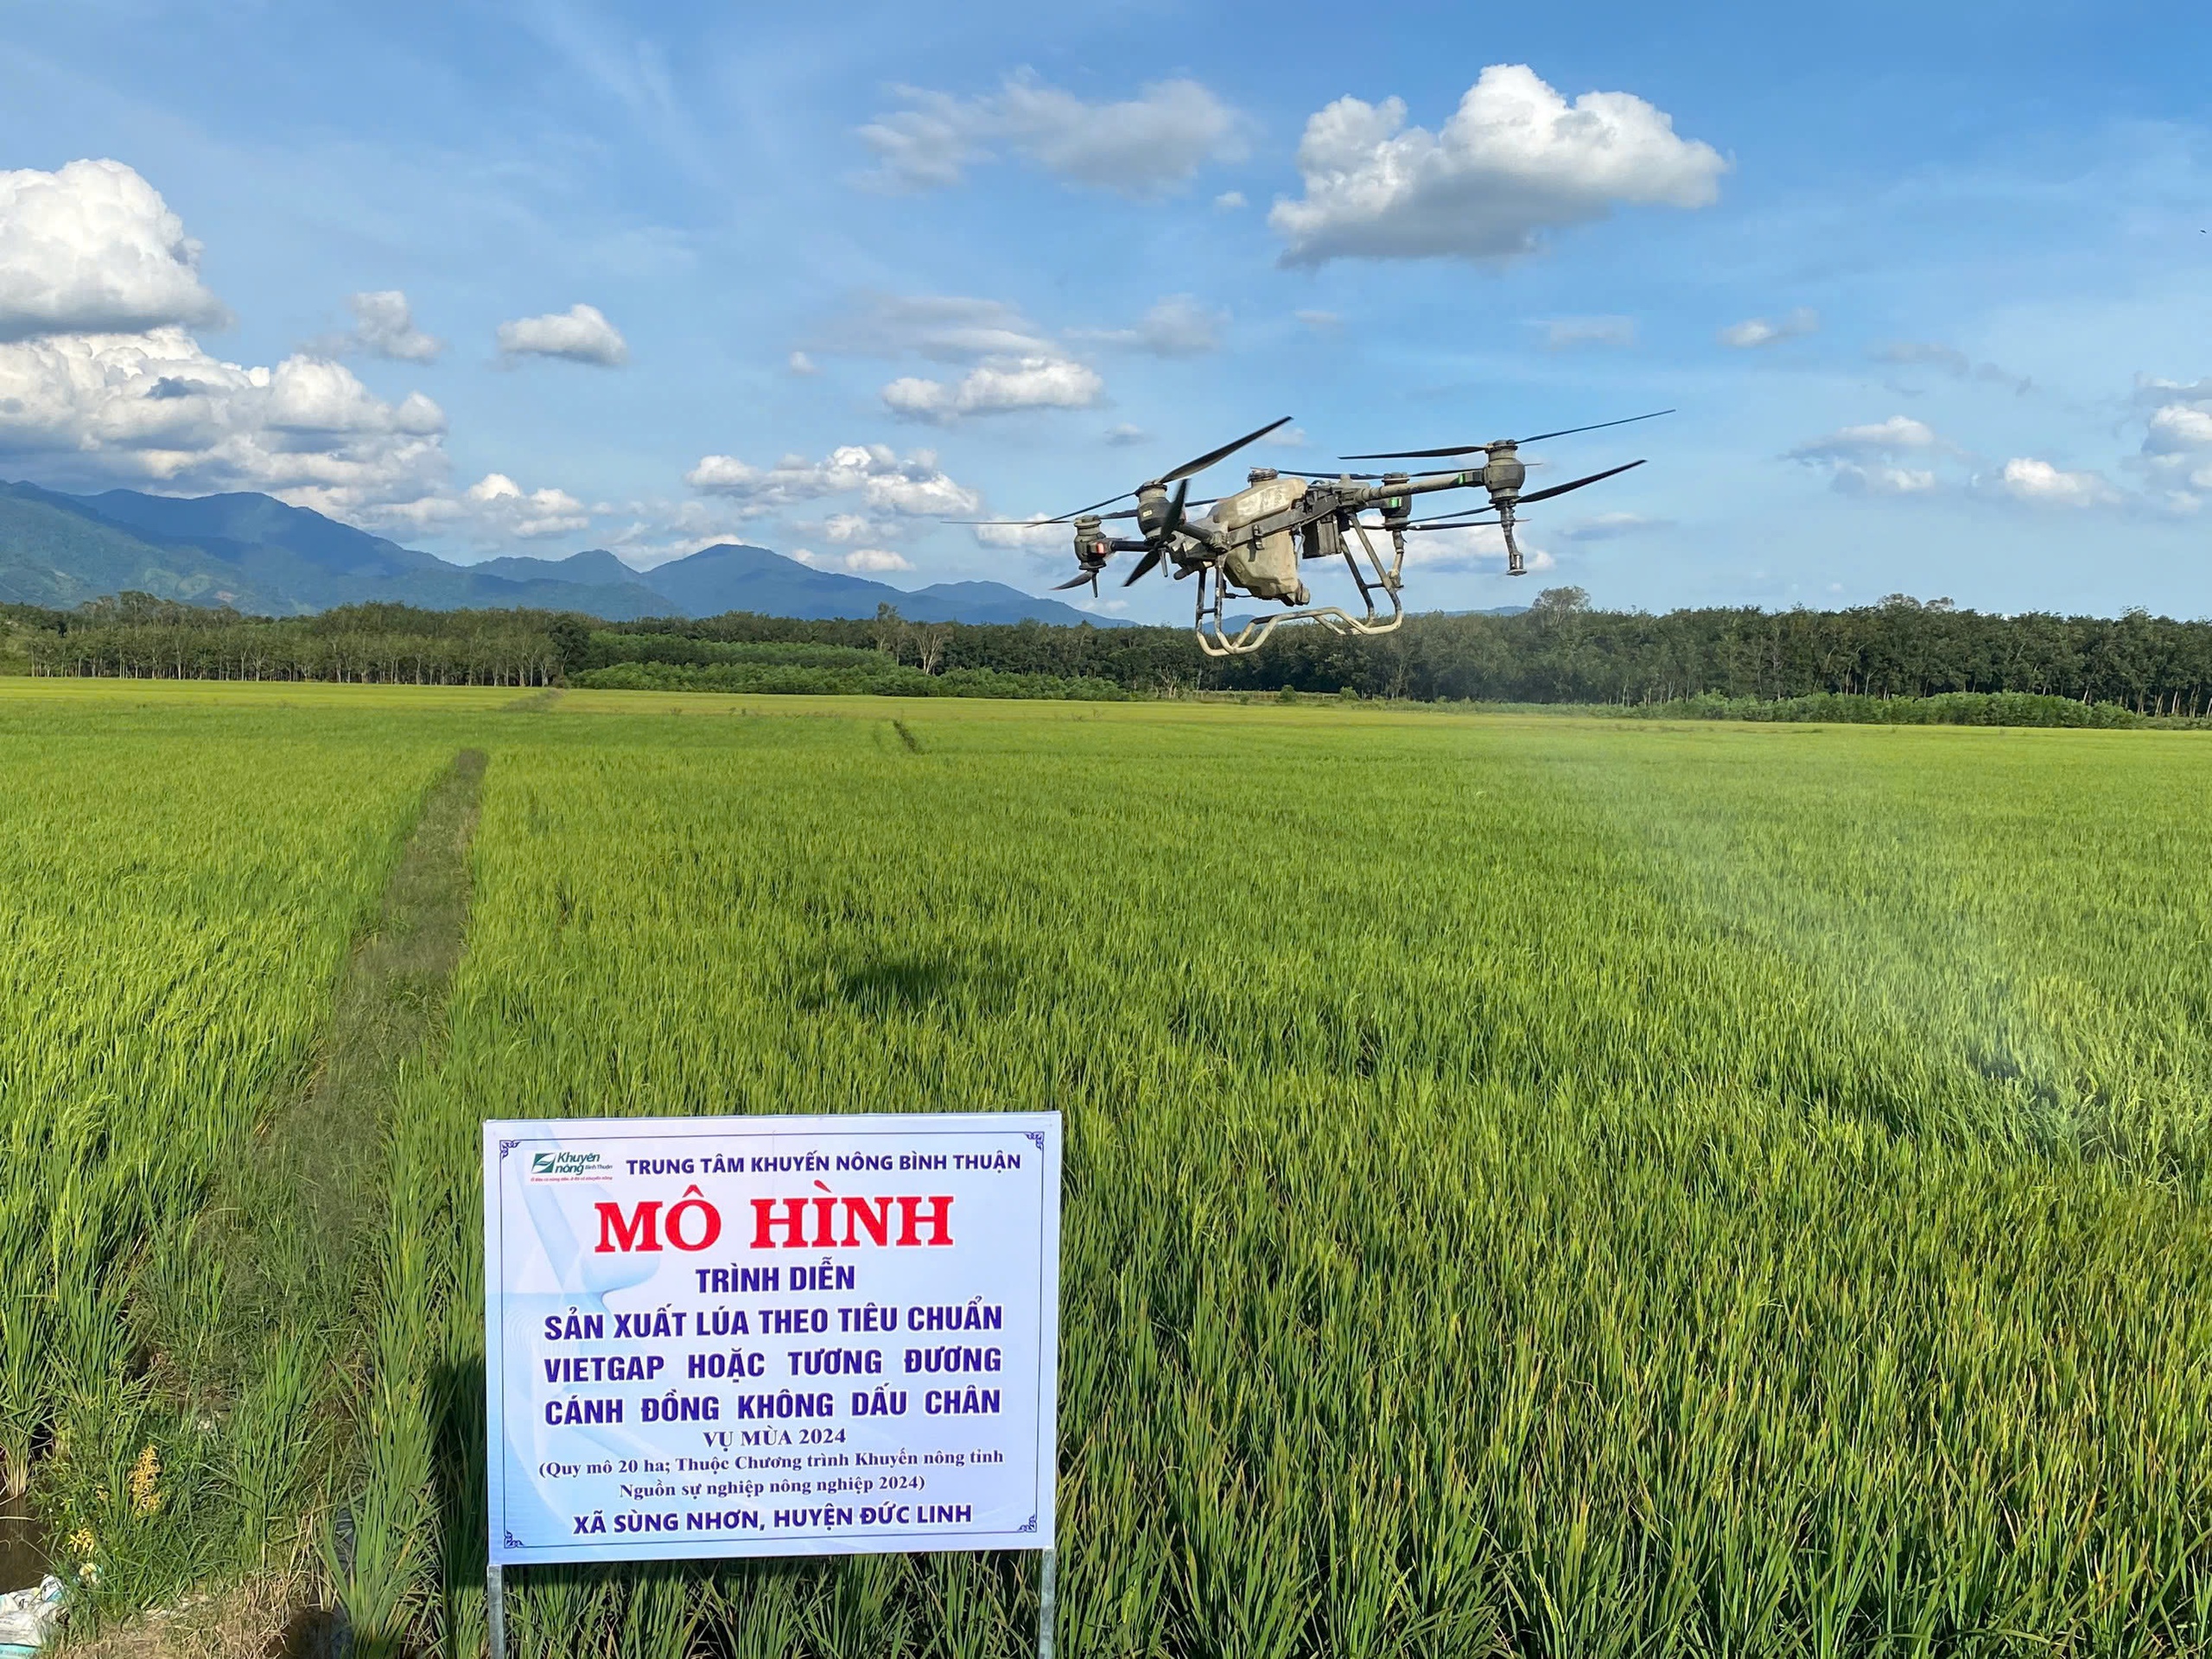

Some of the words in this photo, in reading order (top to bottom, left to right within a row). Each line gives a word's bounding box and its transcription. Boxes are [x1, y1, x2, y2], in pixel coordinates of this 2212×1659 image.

[626, 1158, 695, 1175] TRUNG
[700, 1153, 745, 1173] TÂM
[751, 1150, 830, 1173] KHUYẾN
[836, 1151, 893, 1171] NÔNG
[899, 1150, 947, 1171] BÌNH
[952, 1150, 1021, 1173] THUẬN
[594, 1184, 721, 1253] MÔ
[749, 1179, 954, 1248] HÌNH
[695, 1262, 779, 1294] TRÌNH
[789, 1256, 855, 1291] DIỄN
[544, 1306, 604, 1341] SẢN
[613, 1303, 687, 1338] XUẤT
[696, 1305, 750, 1336] LÚA
[758, 1308, 829, 1334] THEO
[837, 1301, 898, 1332] TIÊU
[907, 1295, 1002, 1332] CHUẨN
[543, 1355, 664, 1383] VIETGAP
[688, 1347, 765, 1383] HOẶC
[787, 1347, 882, 1376] TƯƠNG
[904, 1345, 1001, 1373] ĐƯƠNG
[545, 1395, 623, 1426] CÁNH
[640, 1389, 720, 1422] ĐỒNG
[737, 1389, 834, 1420] KHÔNG
[851, 1382, 907, 1416] DẤU
[925, 1384, 1001, 1415] CHÂN
[702, 1431, 734, 1452] VỤ
[741, 1425, 792, 1446] MÙA
[798, 1427, 847, 1445] 2024
[538, 1462, 580, 1478] (Quy
[587, 1459, 613, 1474] mô
[619, 1459, 639, 1473] 20
[644, 1459, 671, 1473] ha;
[678, 1456, 729, 1475] Thuộc
[734, 1456, 802, 1471] Chương
[807, 1452, 849, 1467] trình
[855, 1447, 918, 1469] Khuyến
[924, 1450, 965, 1467] nông
[969, 1448, 1003, 1464] tỉnh
[620, 1478, 676, 1500] Nguồn
[682, 1483, 702, 1500] sự
[707, 1479, 764, 1498] nghiệp
[770, 1478, 811, 1495] nông
[817, 1476, 874, 1495] nghiệp
[879, 1476, 925, 1491] 2024)
[573, 1510, 607, 1535] XÃ
[613, 1509, 679, 1533] SÙNG
[686, 1509, 766, 1531] NHƠN,
[773, 1503, 853, 1531] HUYỆN
[859, 1501, 910, 1525] ĐỨC
[917, 1504, 971, 1523] LINH
